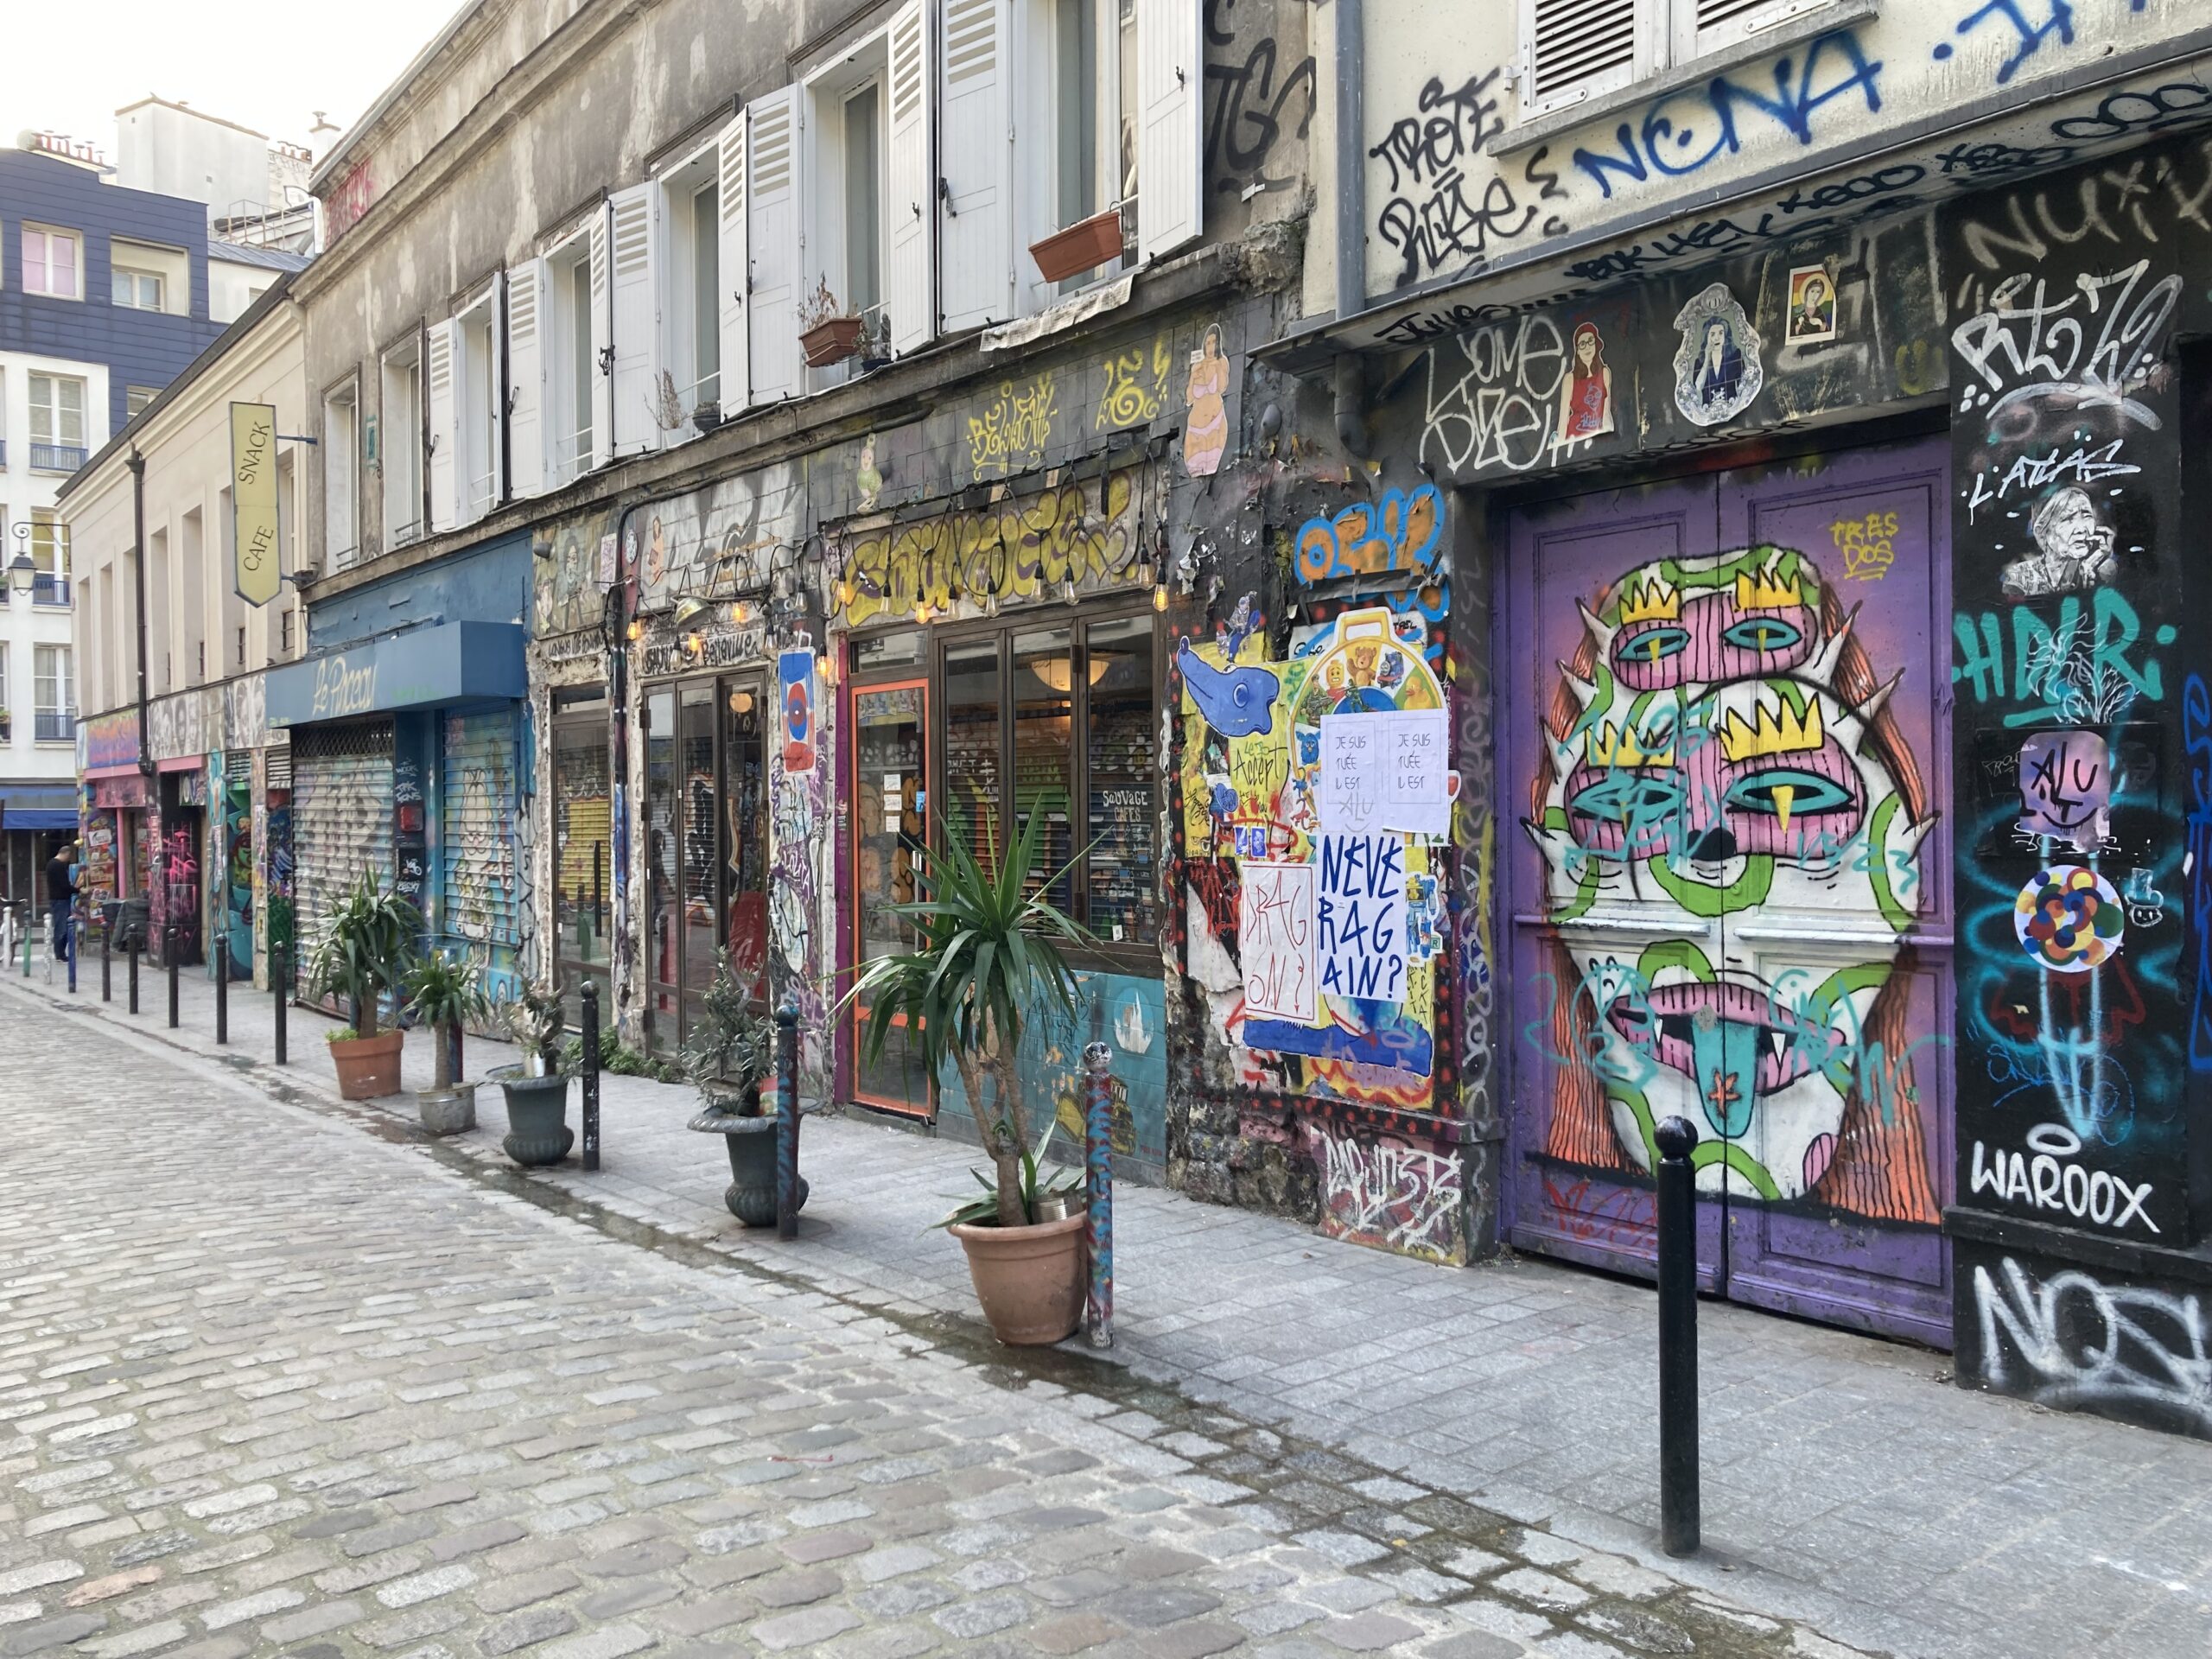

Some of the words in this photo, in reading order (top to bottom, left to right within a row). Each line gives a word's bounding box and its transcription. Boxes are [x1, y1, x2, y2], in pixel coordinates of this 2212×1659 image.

[238, 421, 270, 484] SNACK
[243, 525, 274, 571] CAFE
[1336, 736, 1345, 749] JE
[1349, 735, 1366, 749] SUIS
[1398, 734, 1409, 747] JE
[1413, 733, 1431, 747] SUIS
[1234, 741, 1288, 791] Accept
[1344, 777, 1360, 790] EST
[1408, 776, 1425, 789] EST
[1114, 806, 1141, 822] CAFES
[1321, 835, 1402, 899] NEVE
[1971, 1140, 2161, 1234] WAROOX
